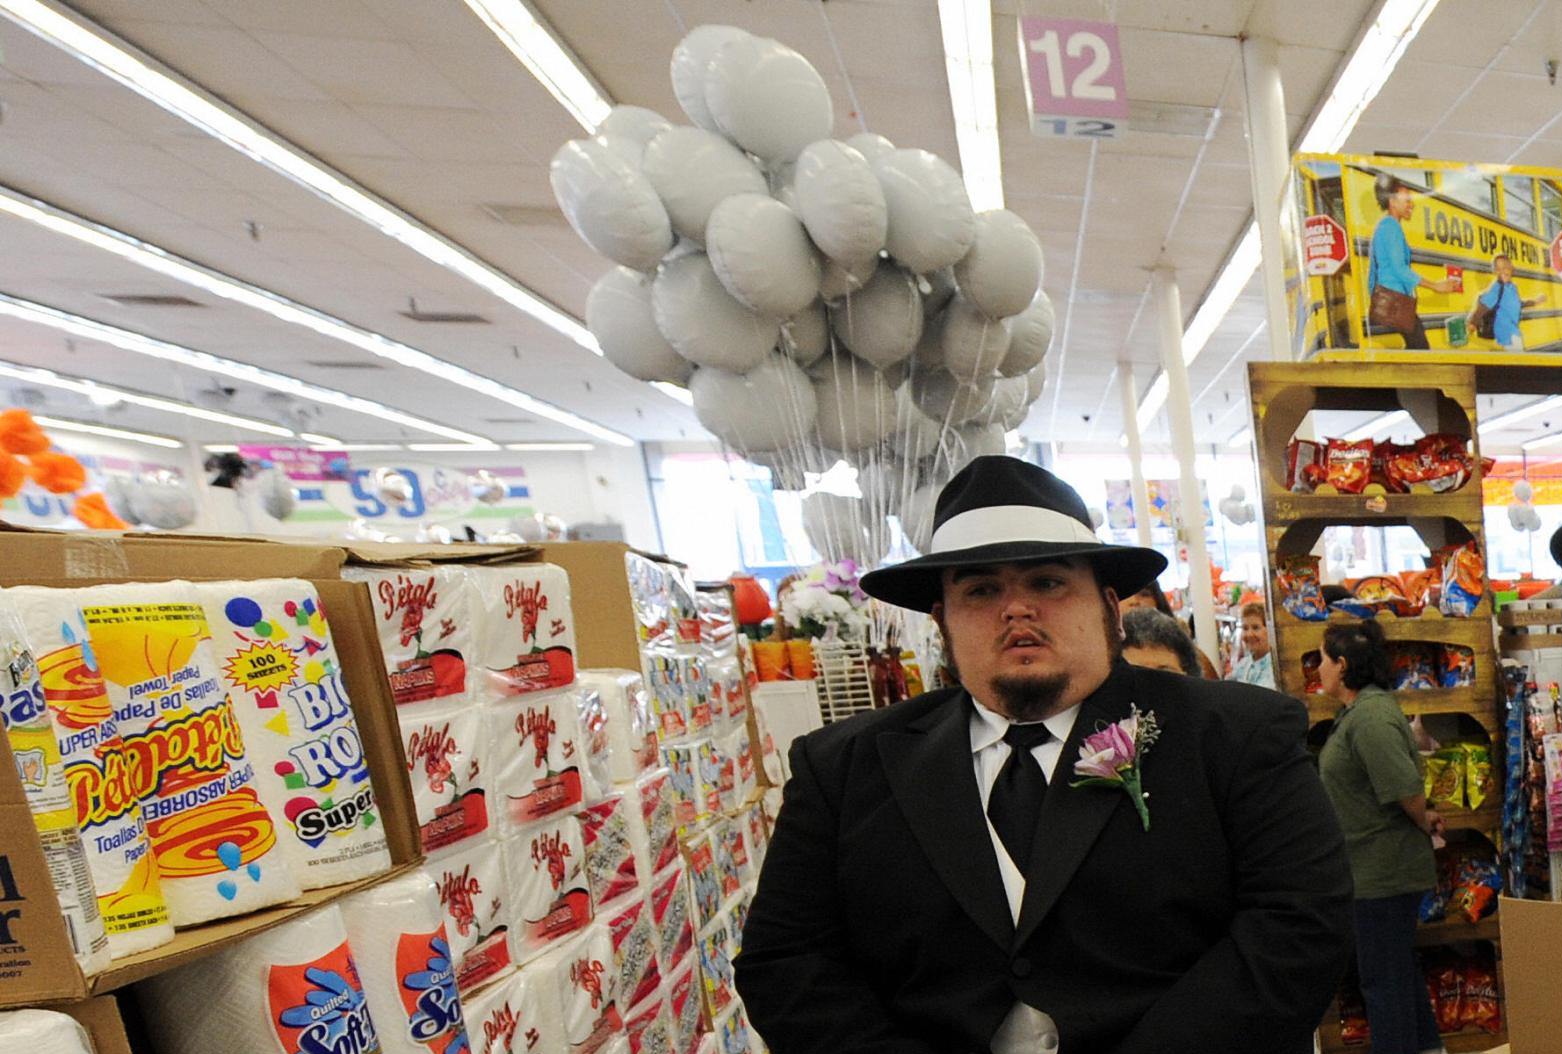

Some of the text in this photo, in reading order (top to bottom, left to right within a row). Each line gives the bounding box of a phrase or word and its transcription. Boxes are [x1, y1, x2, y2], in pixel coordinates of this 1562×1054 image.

[1029, 29, 1117, 99] 12
[1425, 206, 1474, 250] LOAD
[1479, 226, 1498, 254] UP
[1501, 234, 1519, 262] ON
[246, 664, 288, 681] SHEETS
[249, 653, 276, 669] 100
[129, 666, 200, 700] Paper Towel
[161, 691, 182, 711] De
[298, 789, 374, 840] Super
[94, 828, 137, 854] Toallas
[310, 988, 349, 1019] Quilted
